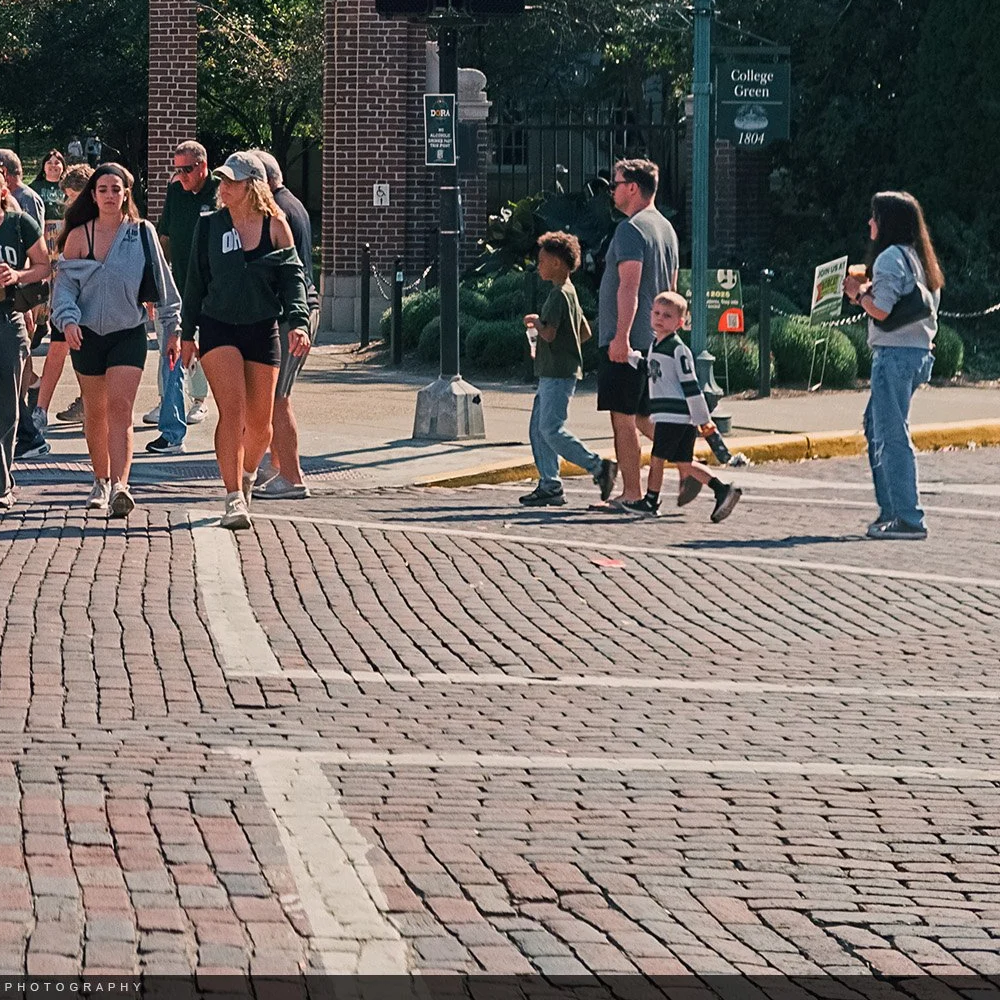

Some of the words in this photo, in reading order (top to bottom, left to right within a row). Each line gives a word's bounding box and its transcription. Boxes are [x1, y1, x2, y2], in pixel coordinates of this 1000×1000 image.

[731, 69, 774, 85] College
[734, 84, 769, 97] Green
[430, 109, 450, 117] DORA
[738, 132, 765, 145] 1804
